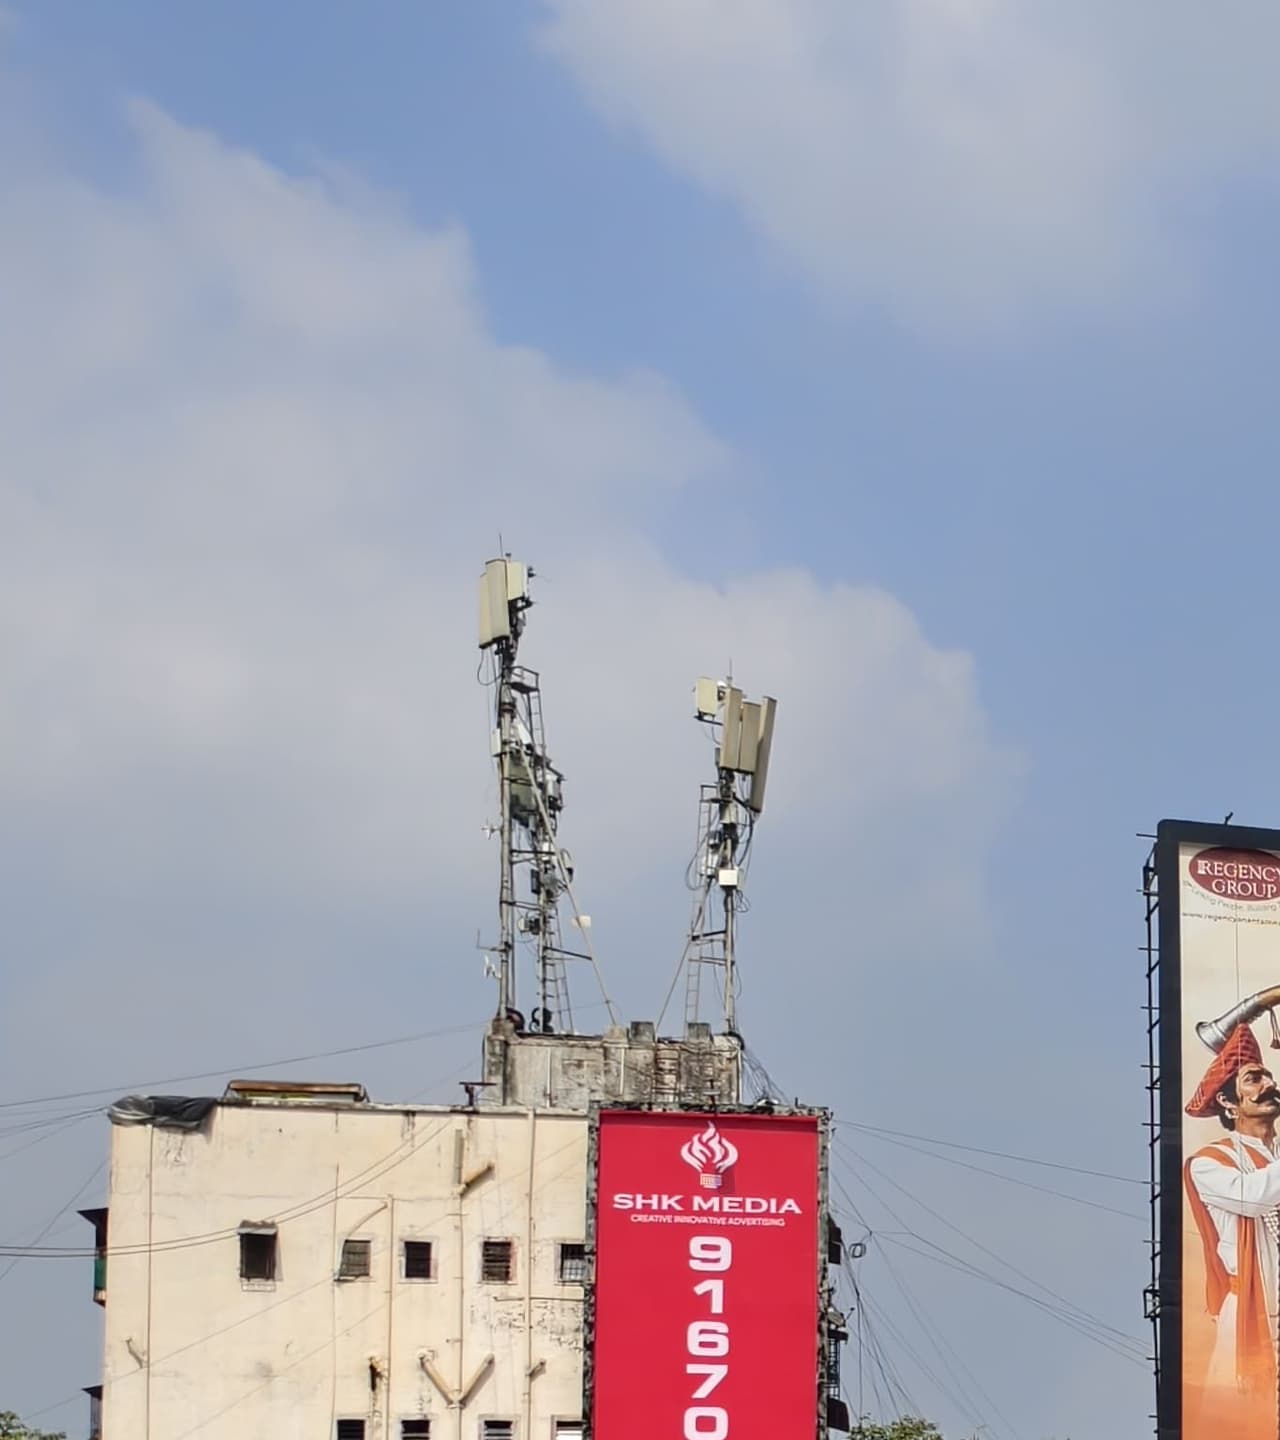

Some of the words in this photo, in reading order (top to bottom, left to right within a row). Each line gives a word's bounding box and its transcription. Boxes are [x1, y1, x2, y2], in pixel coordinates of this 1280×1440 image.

[1211, 878, 1278, 899] GROUP
[612, 1192, 684, 1211] SHK
[692, 1195, 803, 1215] MEDIA
[630, 1213, 673, 1224] CREATIVE
[674, 1214, 727, 1225] INNOVATIVE
[727, 1216, 786, 1228] ADVERTISING
